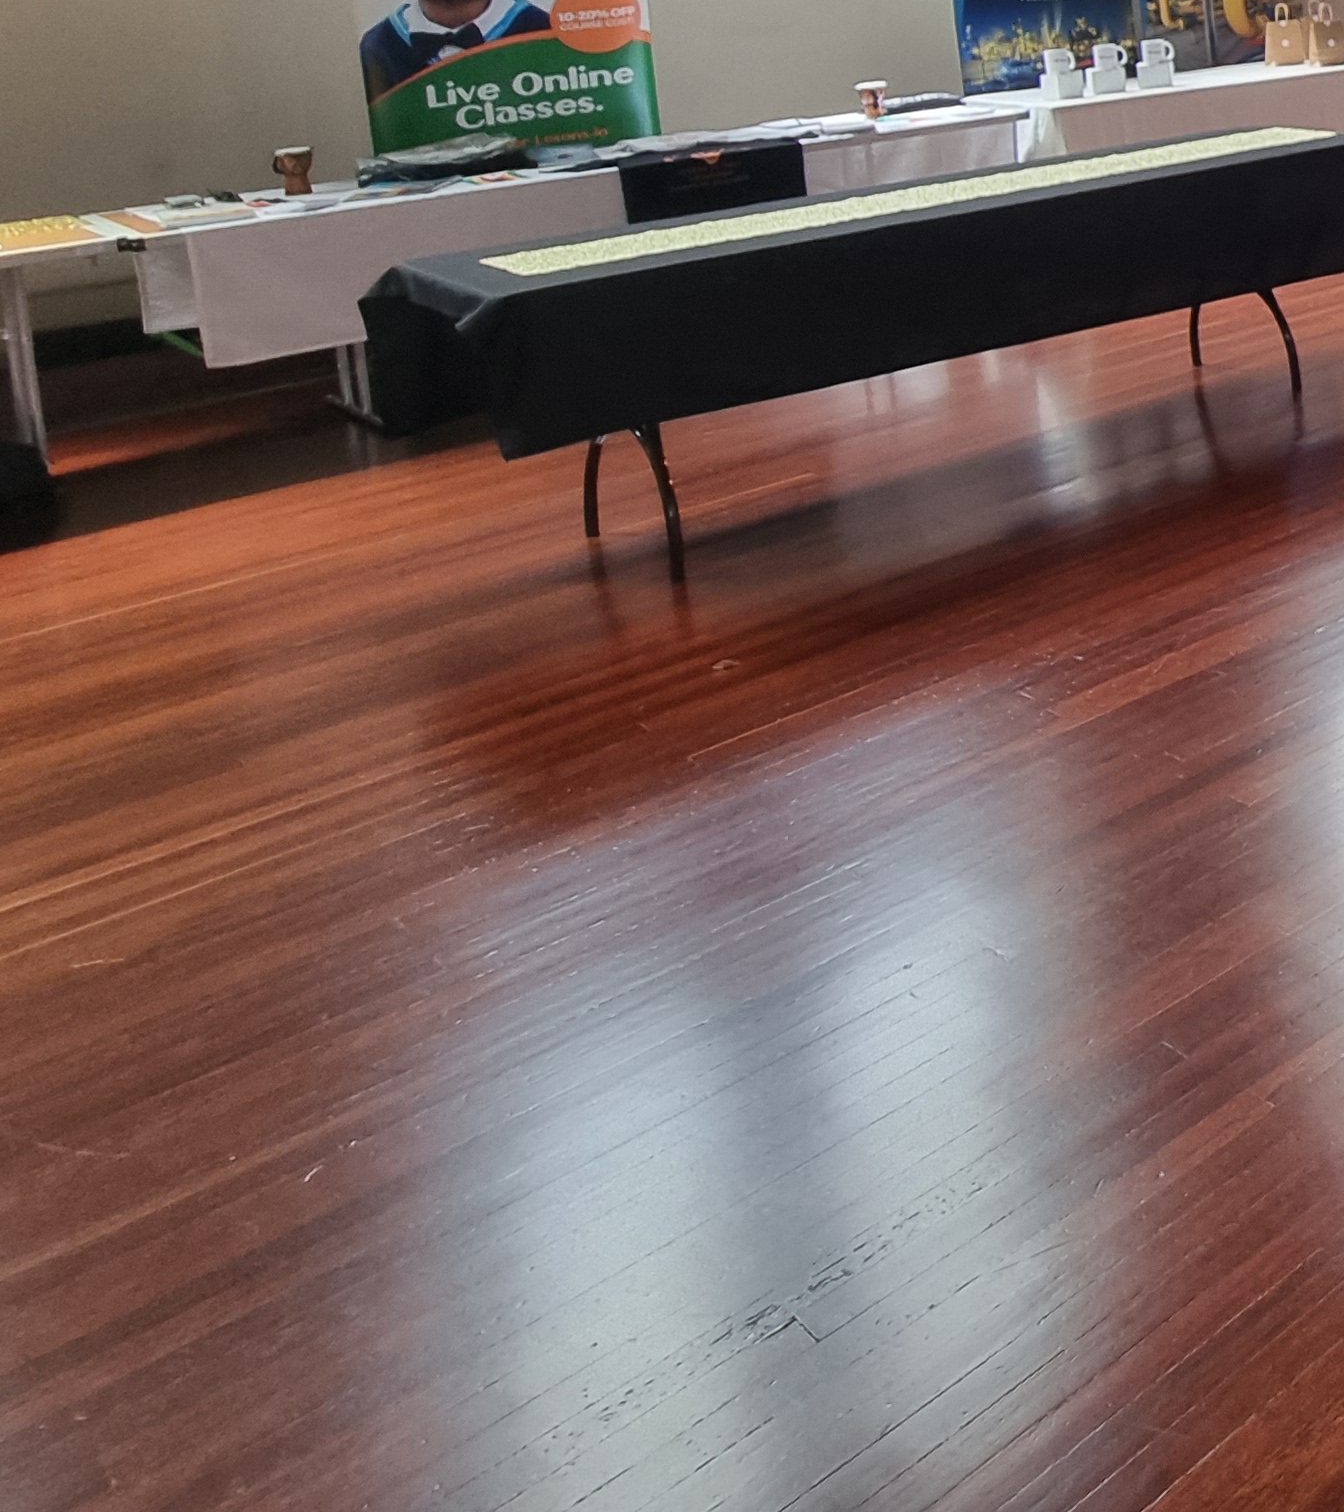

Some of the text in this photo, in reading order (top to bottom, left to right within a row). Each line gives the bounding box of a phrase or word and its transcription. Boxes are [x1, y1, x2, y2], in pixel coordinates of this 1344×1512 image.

[425, 65, 635, 109] Live Online
[455, 95, 604, 130] Classes.
